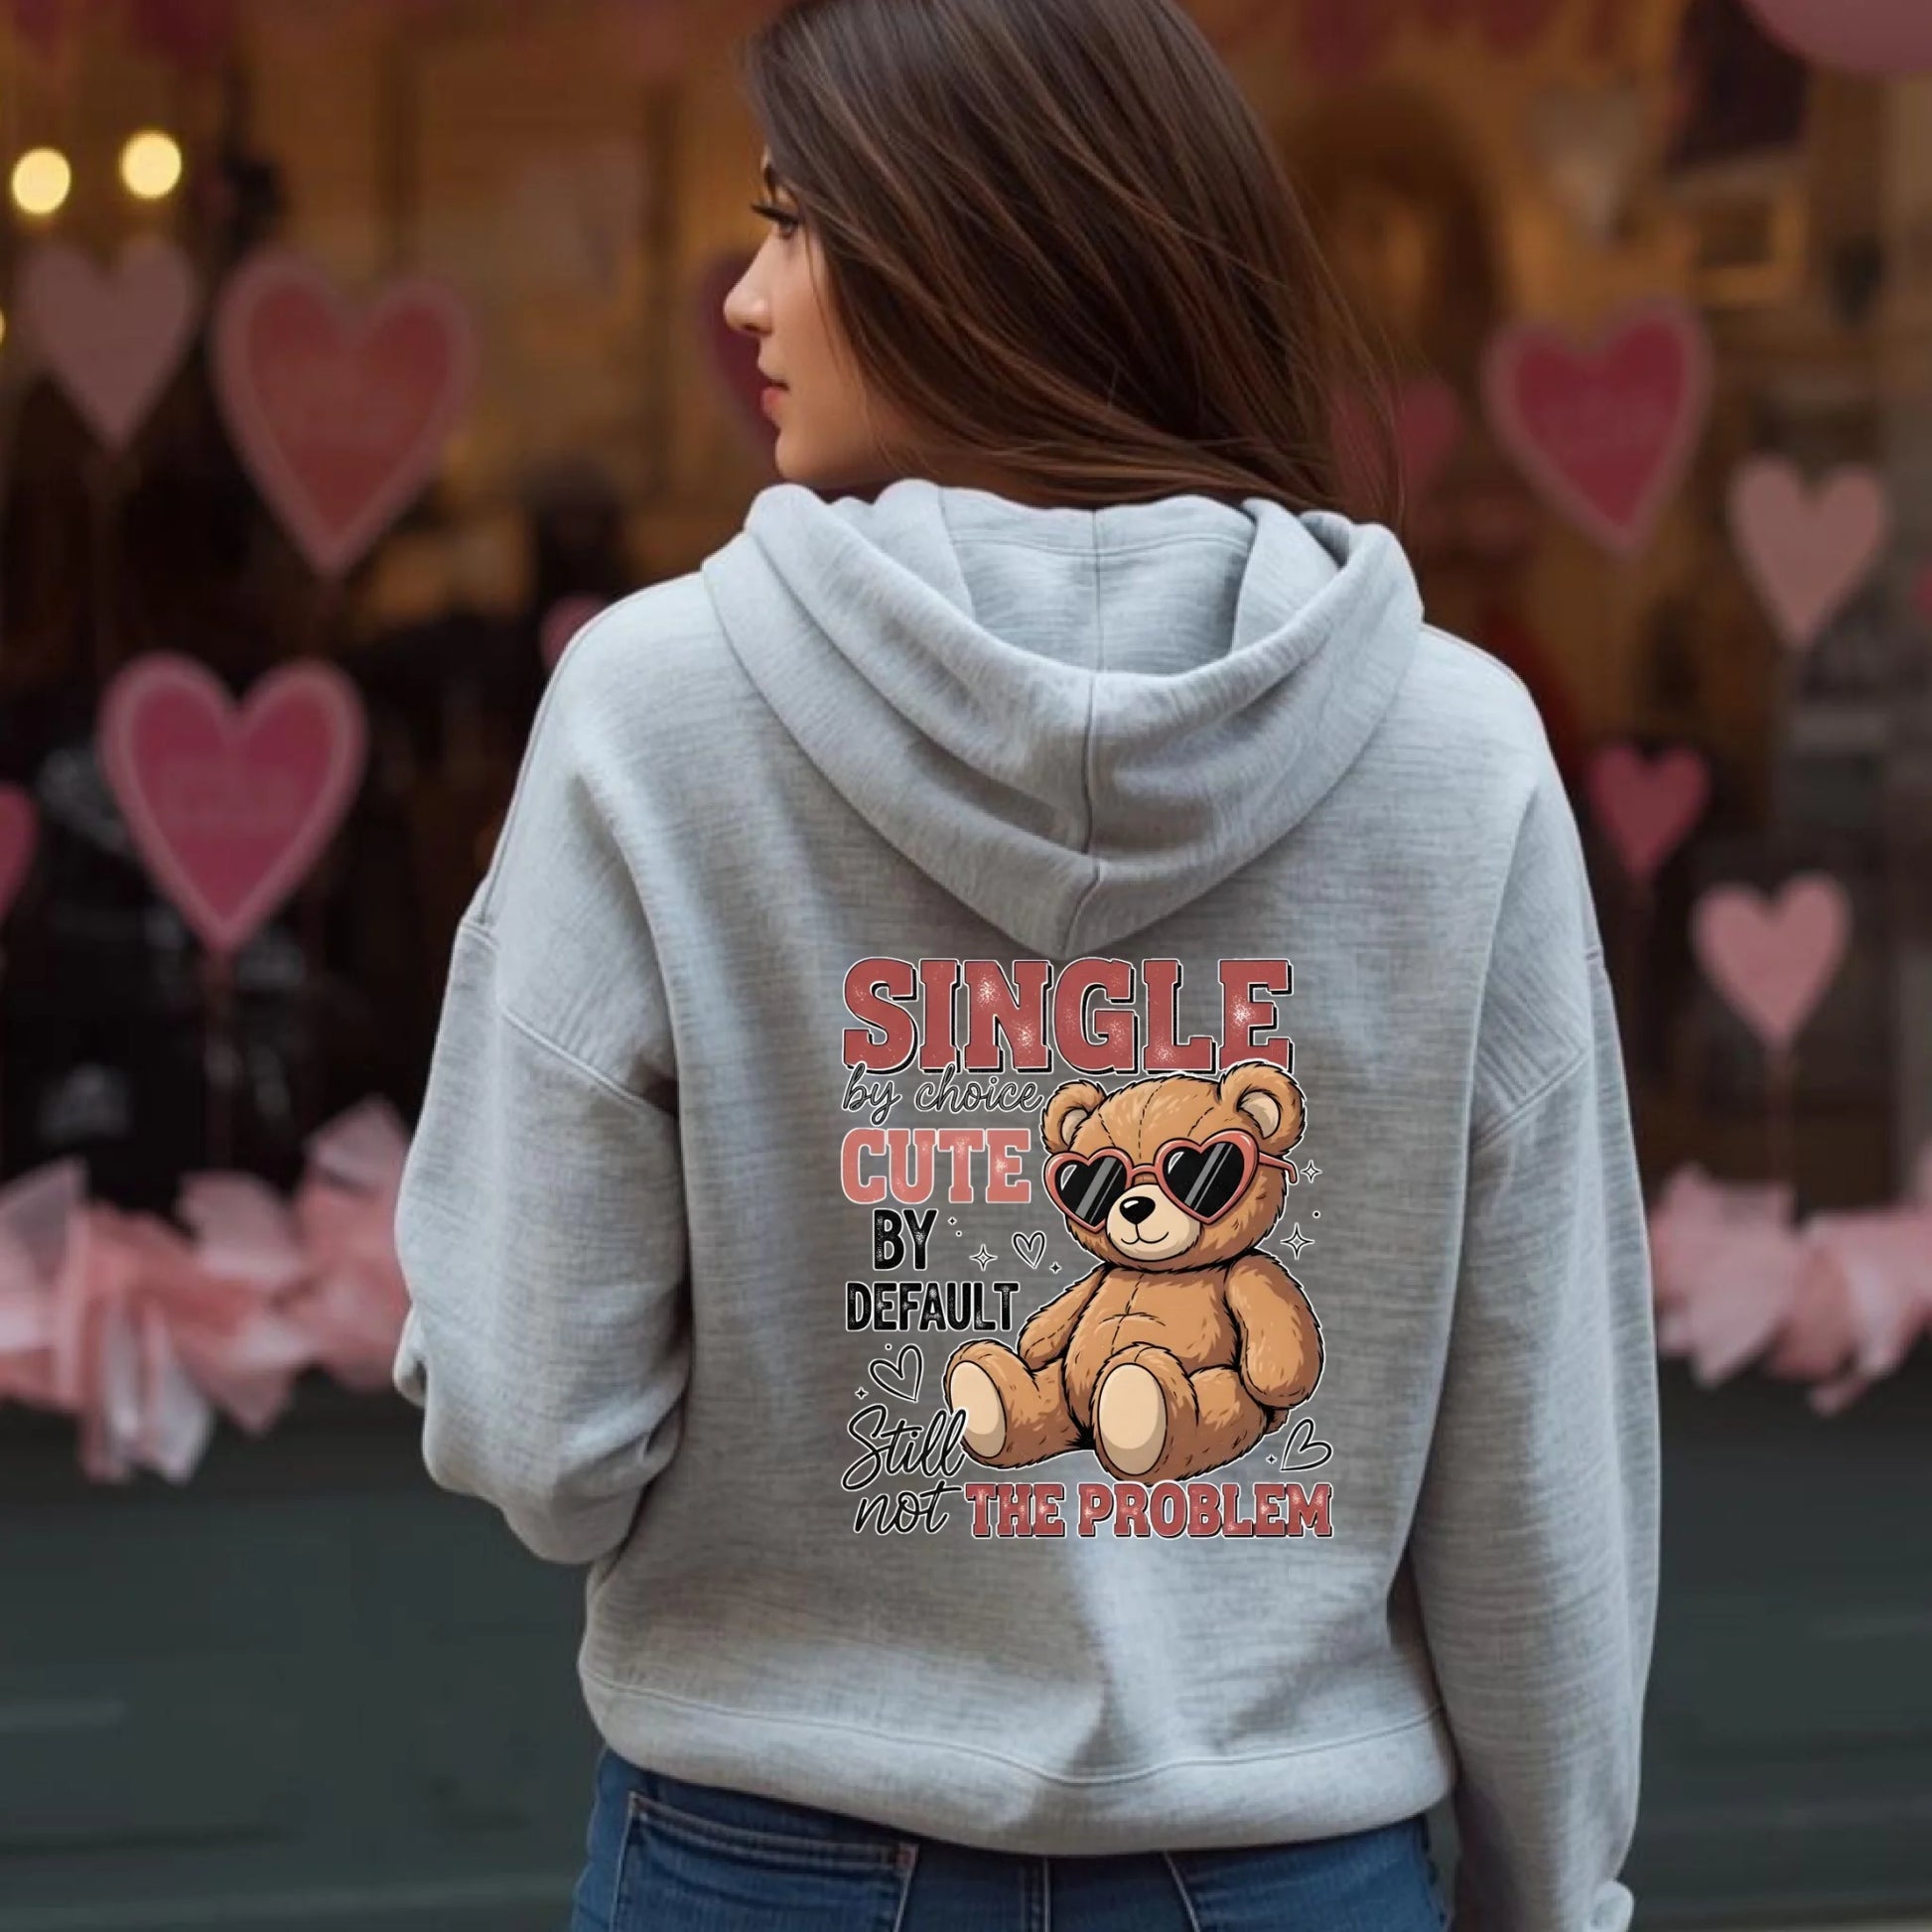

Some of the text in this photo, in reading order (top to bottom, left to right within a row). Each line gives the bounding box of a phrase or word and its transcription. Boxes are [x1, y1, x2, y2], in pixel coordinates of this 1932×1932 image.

[843, 958, 1293, 1074] SINGLE
[842, 1062, 1044, 1124] by choice
[841, 1128, 1031, 1202] CUTE
[872, 1208, 938, 1271] BY
[846, 1282, 1019, 1331] DEFAULT
[842, 1405, 969, 1490] Still
[854, 1480, 1333, 1538] not THE PROBLEM
